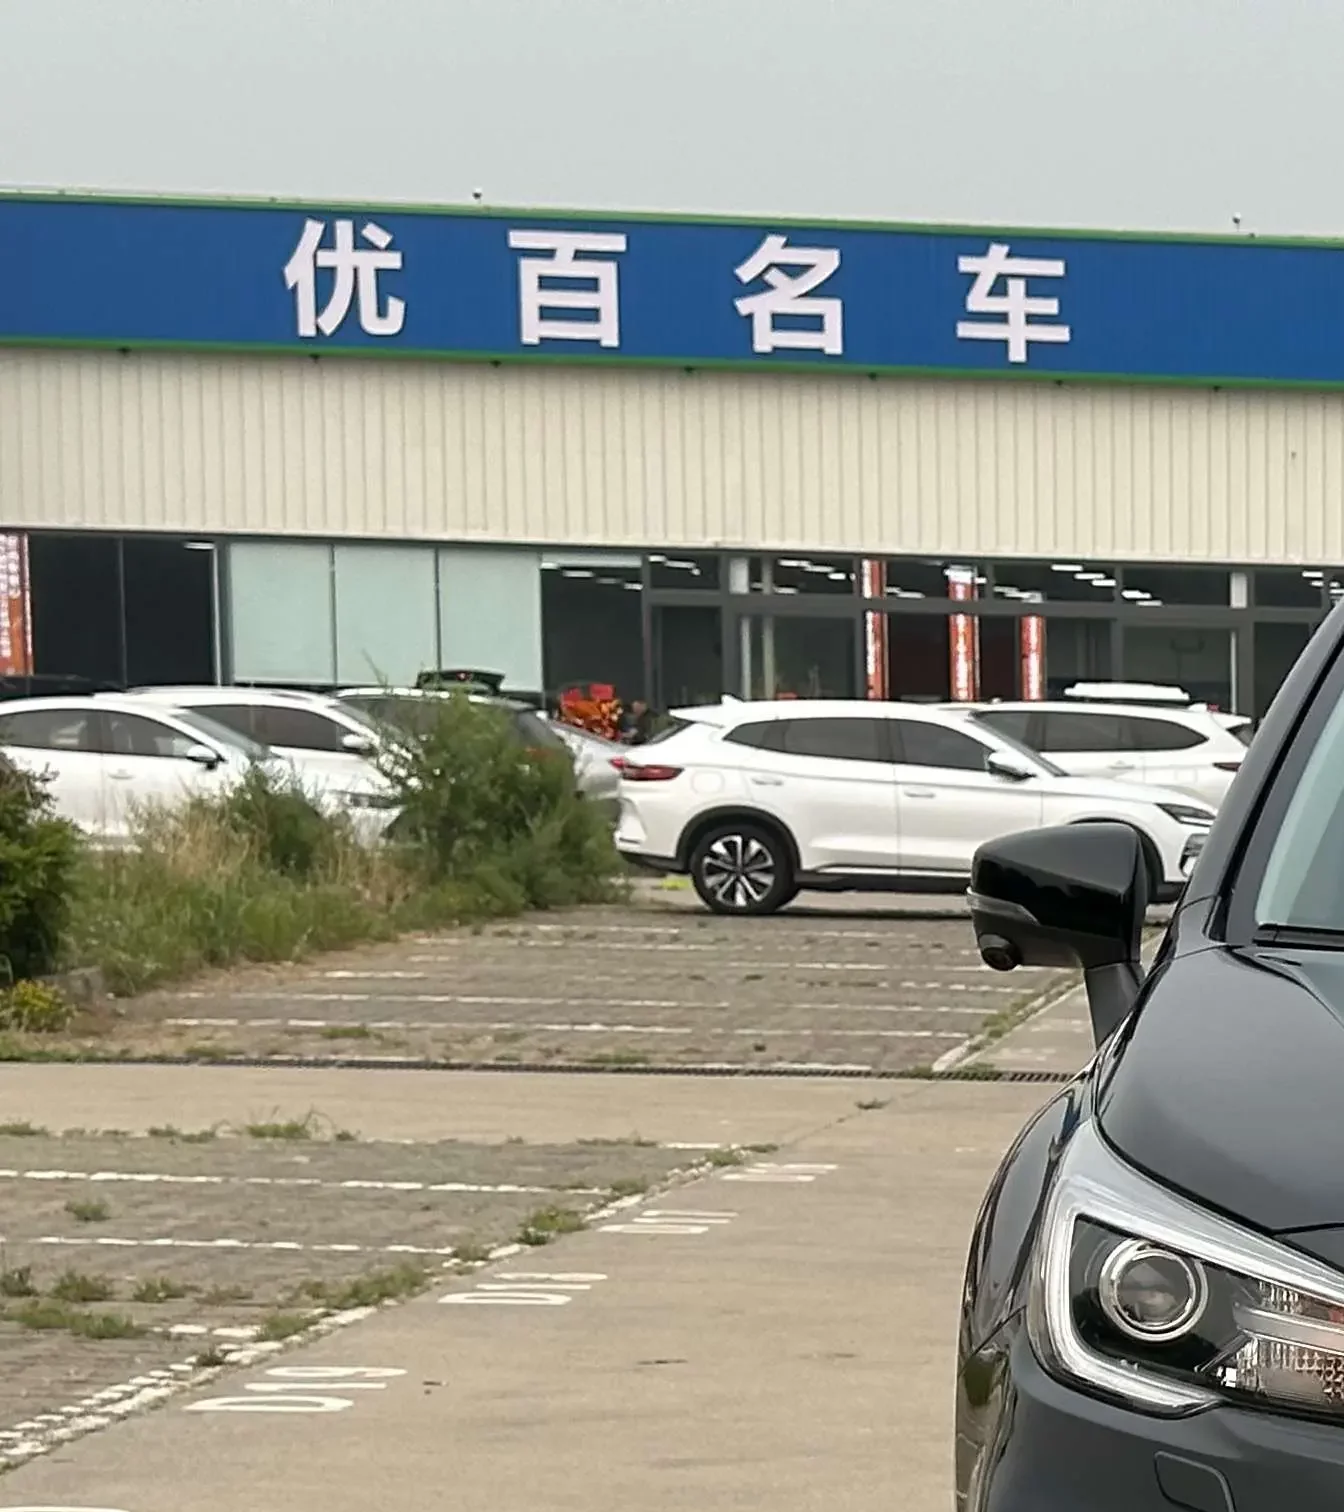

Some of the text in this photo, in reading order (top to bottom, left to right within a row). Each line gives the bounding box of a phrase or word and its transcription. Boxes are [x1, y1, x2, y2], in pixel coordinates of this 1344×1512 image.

[284, 218, 1071, 363] 优百名车
[183, 1366, 407, 1412] D19
